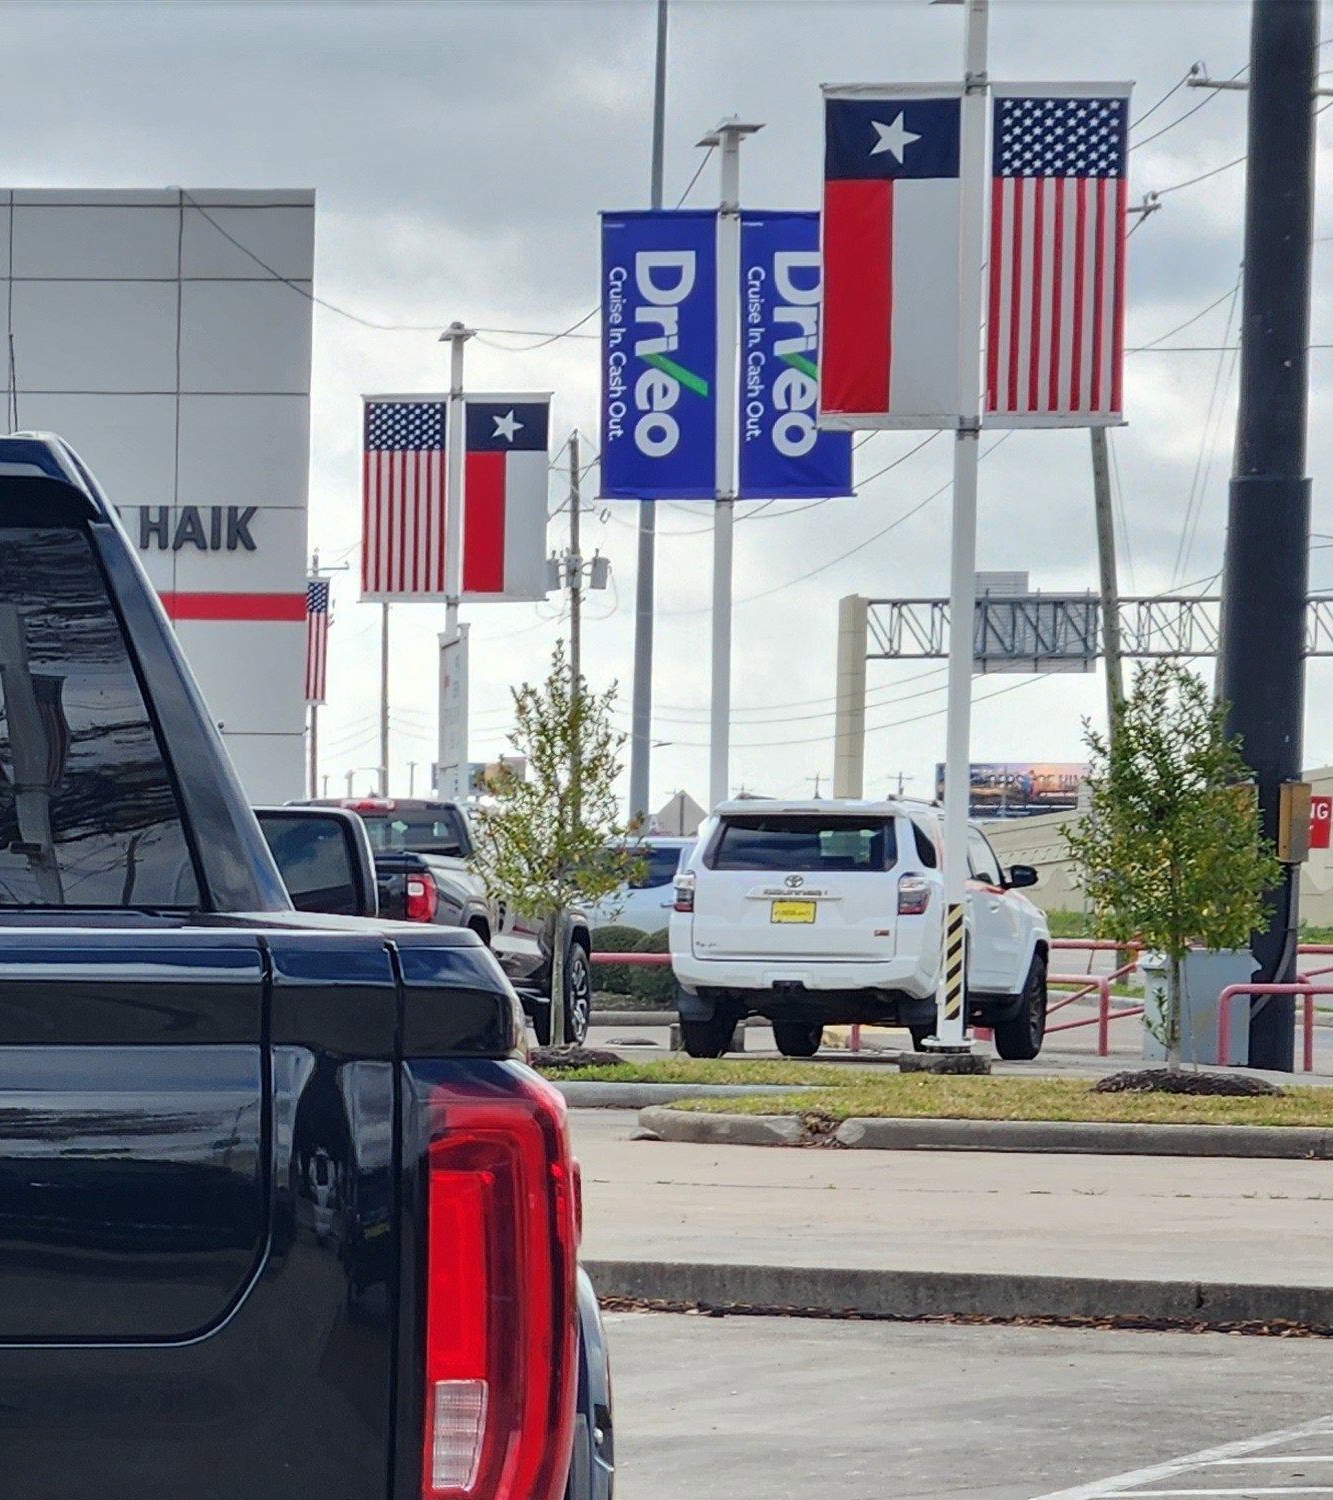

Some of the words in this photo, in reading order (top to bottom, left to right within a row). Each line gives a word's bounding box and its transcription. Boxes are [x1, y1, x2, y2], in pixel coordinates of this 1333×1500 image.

[609, 266, 628, 324] Cruise
[747, 266, 766, 324] Cruise
[609, 351, 627, 398] Cash
[747, 351, 766, 397] Cash
[608, 401, 627, 442] Out.
[745, 401, 765, 442] Out.
[139, 505, 258, 551] HAIK
